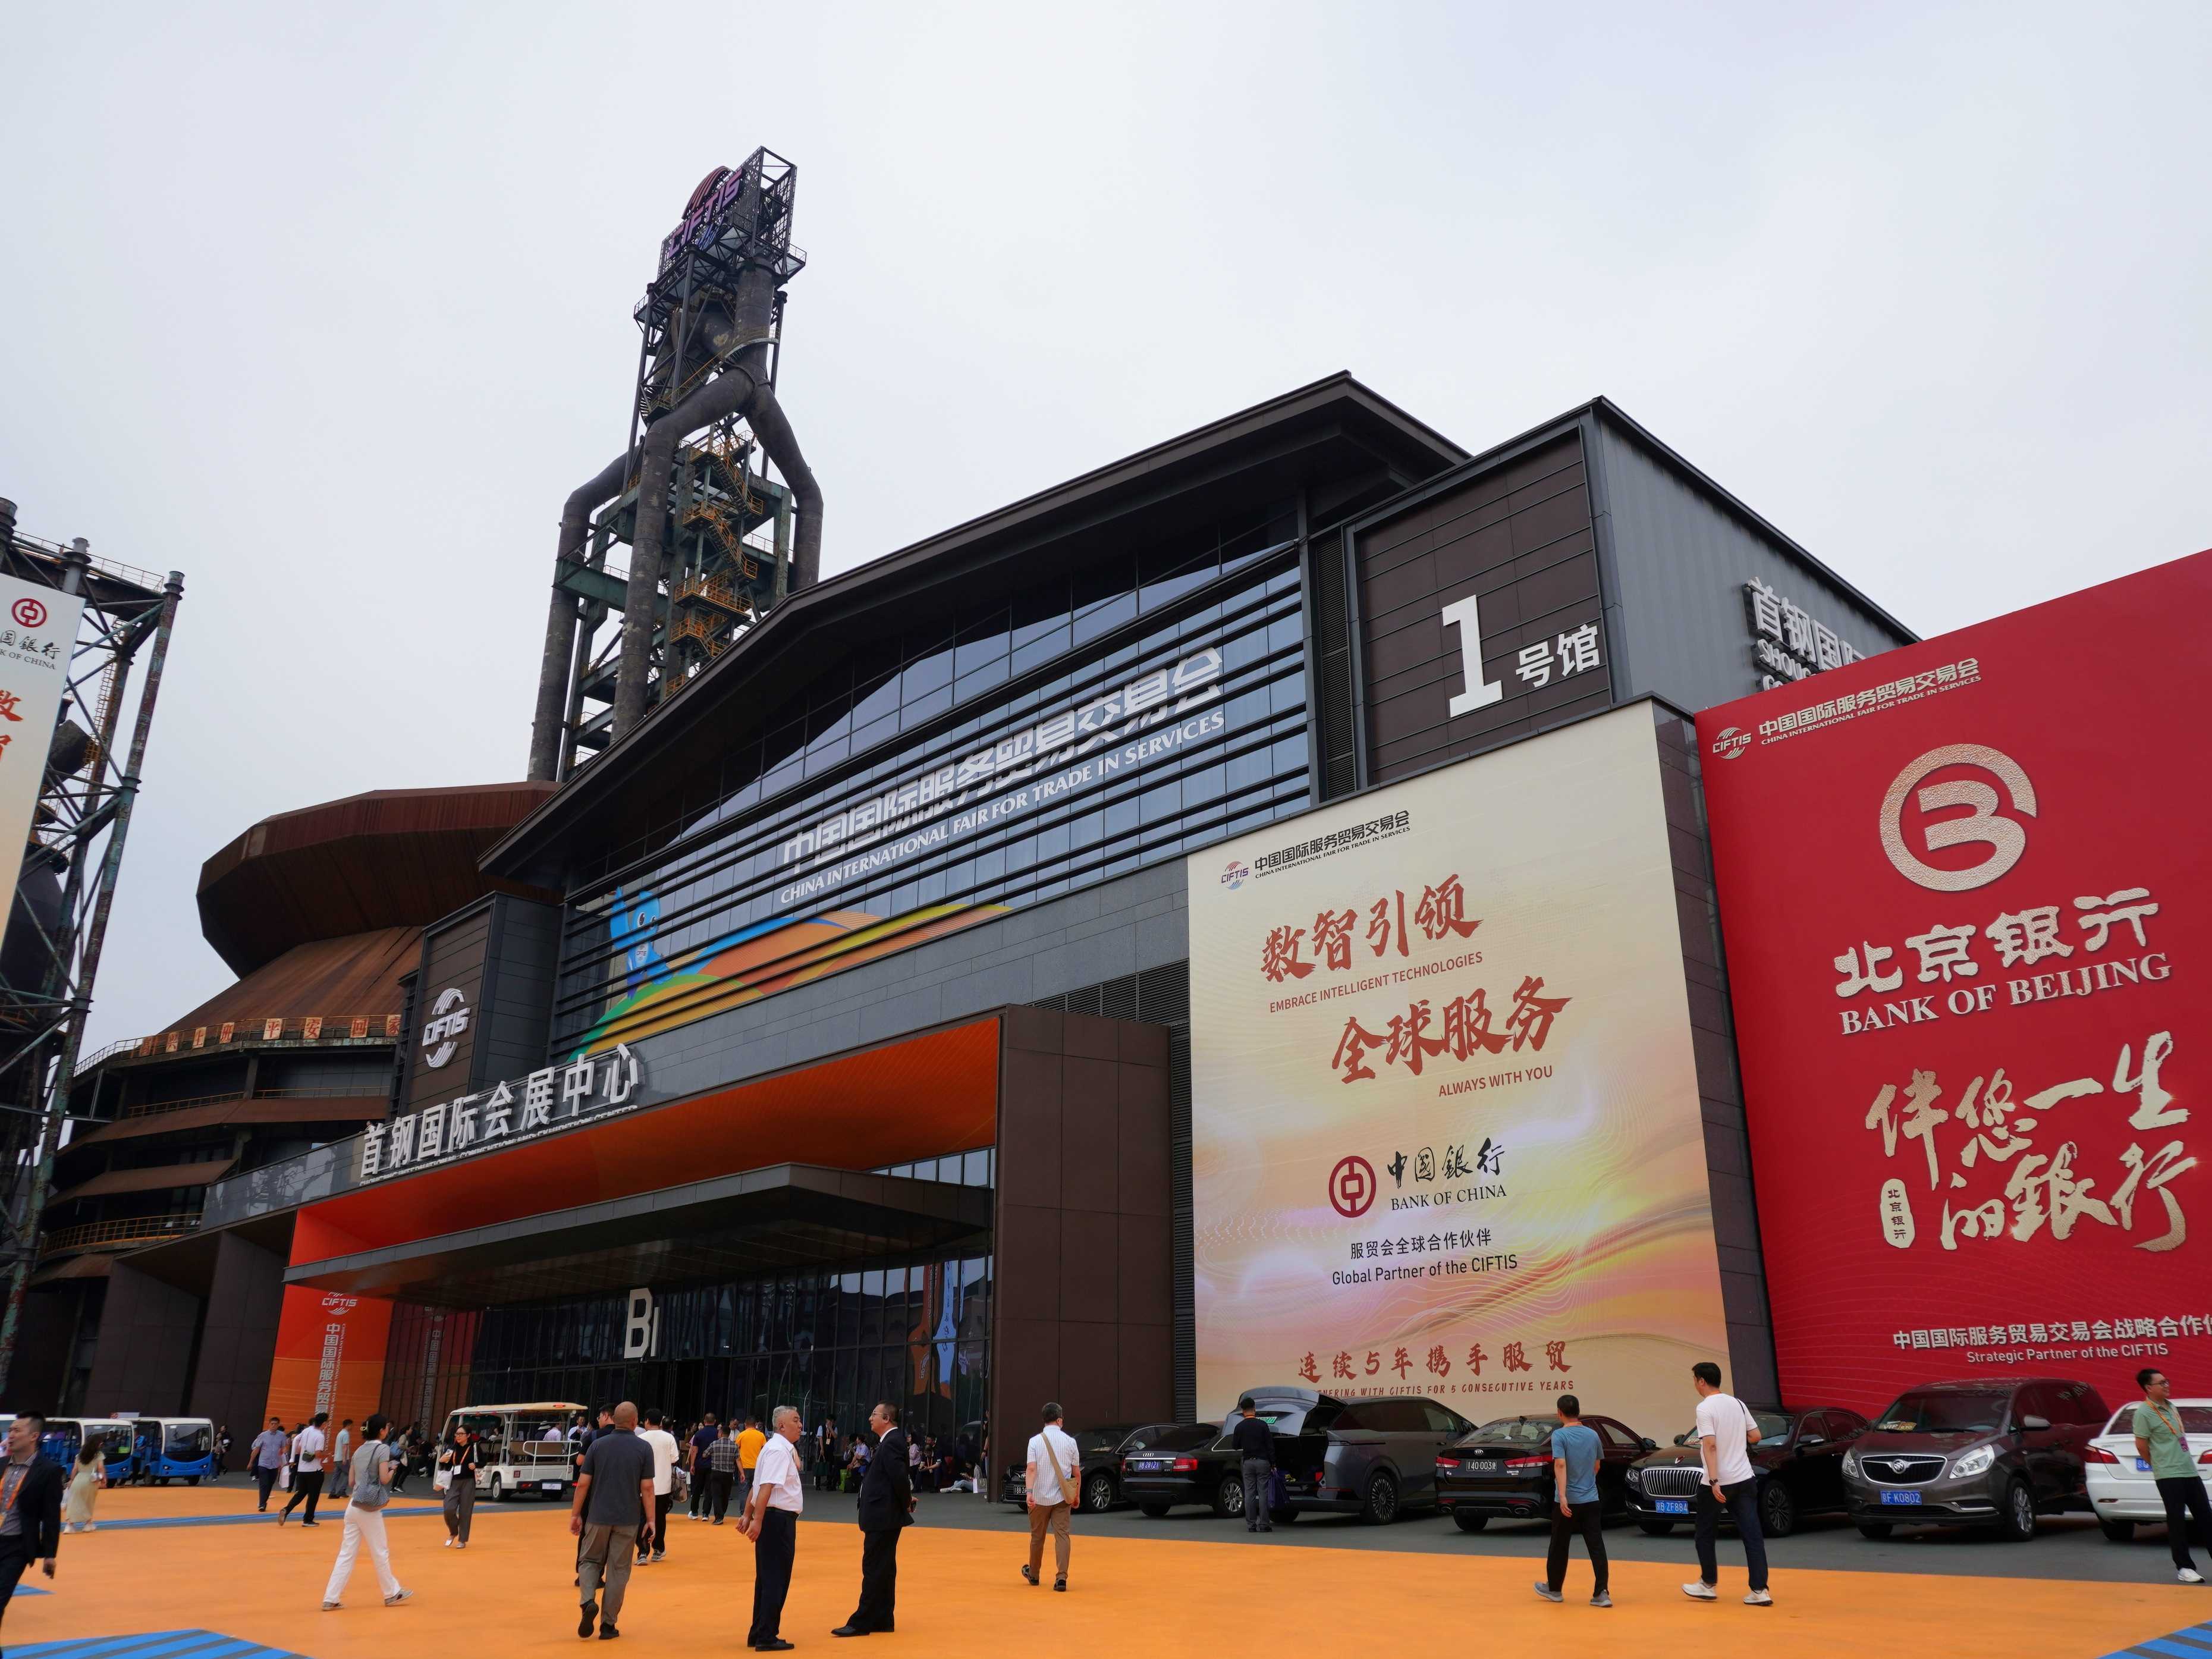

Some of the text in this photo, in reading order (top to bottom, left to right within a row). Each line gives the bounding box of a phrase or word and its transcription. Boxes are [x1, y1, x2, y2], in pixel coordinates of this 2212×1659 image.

[24, 656, 55, 670] CHINA
[1759, 658, 1979, 736] 中国国际服务贸易交易会
[1761, 734, 1788, 745] CHINA
[1789, 714, 1855, 737] INTERNATIONAL
[1858, 707, 1876, 717] FAIR
[1877, 702, 1895, 711] FOR
[1896, 692, 1925, 705] TRADE
[1939, 675, 1982, 693] SERVICES
[1713, 733, 1751, 753] CIFTIS
[781, 711, 1224, 903] CHINA INTERNATIONAL FAIR FOR TRADE IN SERVICES
[1255, 810, 1409, 871] 中国国际服务贸易交易会
[1255, 870, 1274, 879] CHINA
[1275, 854, 1322, 872] INTERNATIONAL
[1324, 849, 1336, 857] FAIR
[1337, 845, 1350, 853] FOR
[1350, 839, 1371, 849] TRADE
[1381, 827, 1411, 840] SERVICES
[1221, 867, 1249, 883] CIFTIS
[1260, 874, 1483, 983] 数智引领
[1270, 951, 1483, 1013] EMBRACE INTELLIGENT TECHNOLOGIES
[1839, 953, 2173, 1035] BANK OF BEIJING
[1331, 975, 1573, 1085] 全球服务
[1439, 1065, 1553, 1097] ALWAYS WITH YOU
[360, 1043, 638, 1178] 首钢国际会展中心
[1391, 1184, 1507, 1211] BANK OF CHINA
[1351, 1228, 1492, 1259] 服贸会全球合作伙伴
[1333, 1254, 1517, 1285] Global Partner of the CIFTIS
[322, 1297, 358, 1307] CIFTIS
[1966, 1343, 2169, 1363] Strategic Partner of the CIFTIS
[1361, 1387, 1384, 1396] WITH
[1390, 1386, 1422, 1395] CIFTIS
[1427, 1384, 1446, 1394] FOR
[1462, 1382, 1534, 1393] CONSECUTIVE
[1540, 1380, 1574, 1390] YEARS
